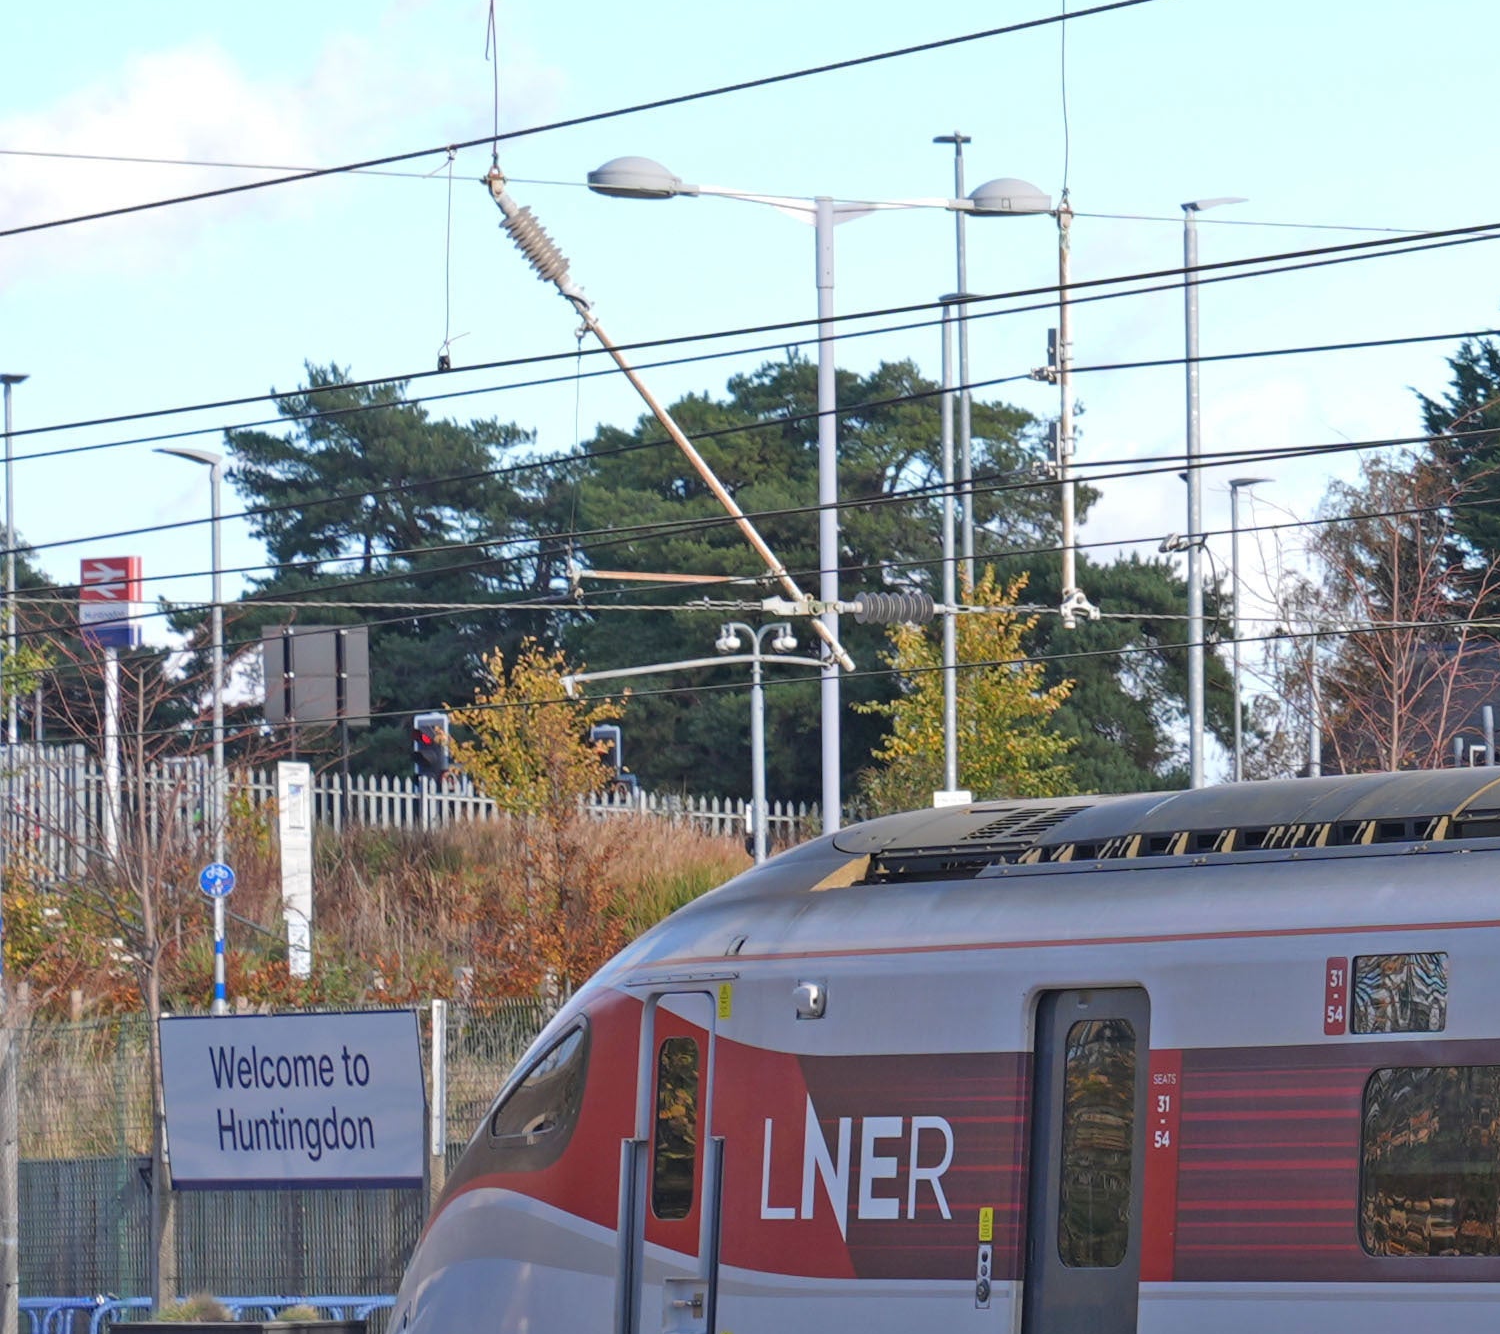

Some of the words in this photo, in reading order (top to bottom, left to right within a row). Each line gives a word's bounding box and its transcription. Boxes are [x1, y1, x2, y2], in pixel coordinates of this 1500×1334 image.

[1330, 969, 1343, 987] 31
[1327, 1005, 1343, 1024] 54
[208, 1045, 334, 1089] Welcome
[341, 1045, 370, 1087] to
[1153, 1073, 1177, 1085] SEATS
[1157, 1095, 1170, 1113] 31
[216, 1105, 375, 1162] Huntingdon
[1154, 1130, 1171, 1148] 54
[760, 1091, 955, 1244] LNER
